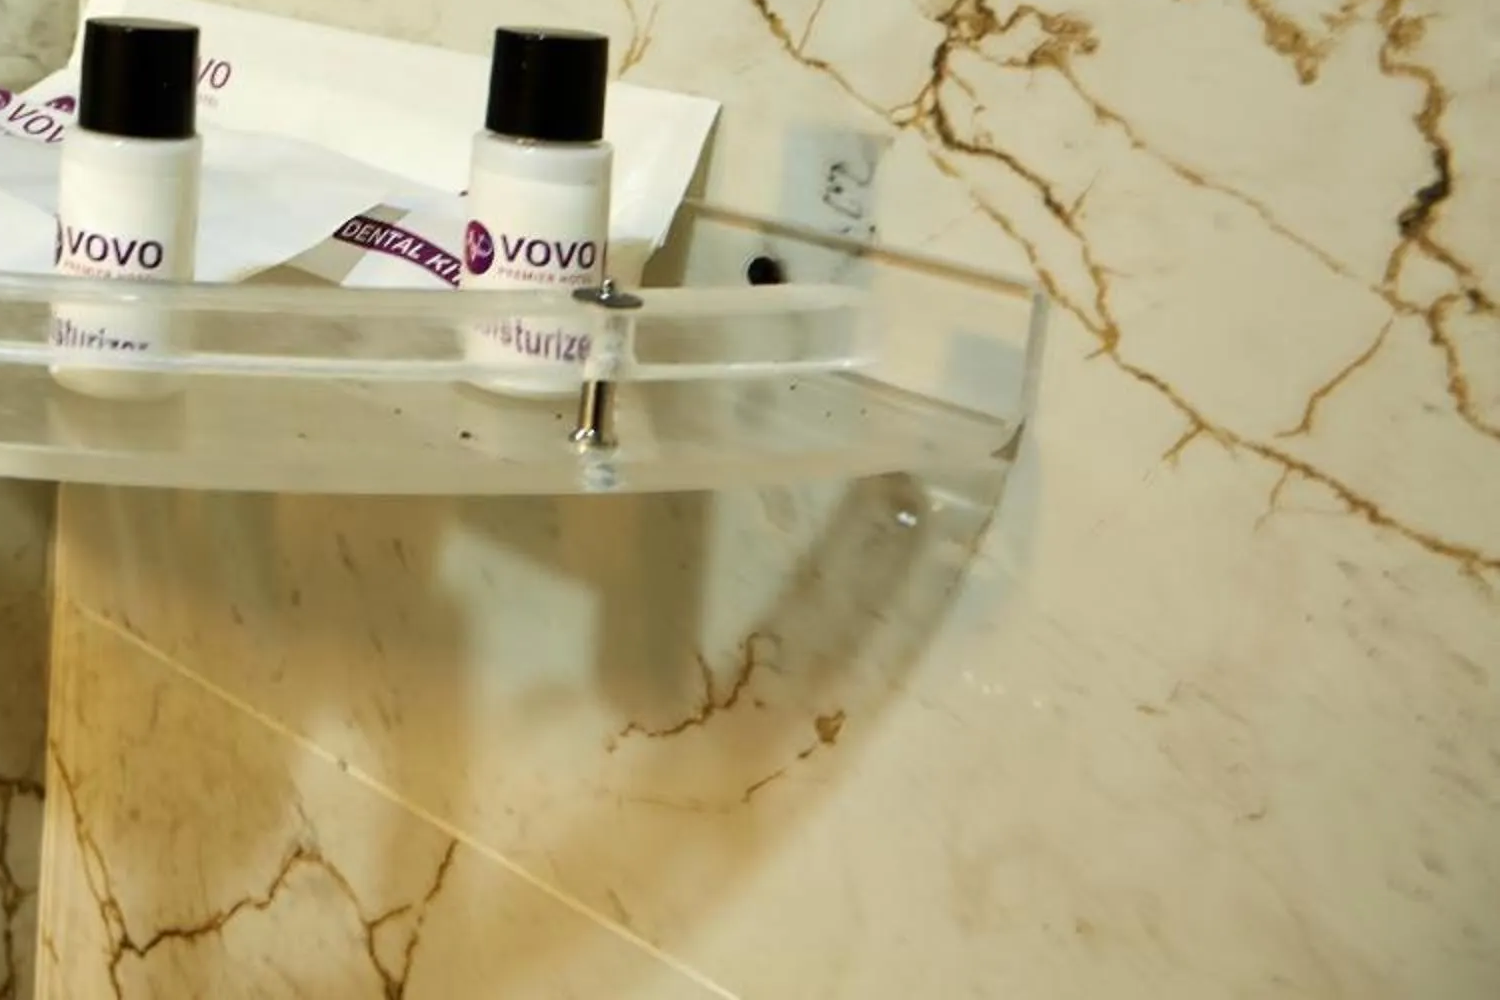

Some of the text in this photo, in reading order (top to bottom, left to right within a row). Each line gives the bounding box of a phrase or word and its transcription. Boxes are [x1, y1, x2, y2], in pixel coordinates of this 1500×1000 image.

[7, 103, 66, 143] VOV
[66, 226, 164, 270] VOVO
[341, 220, 423, 260] DENTAL
[500, 234, 597, 269] VOVO
